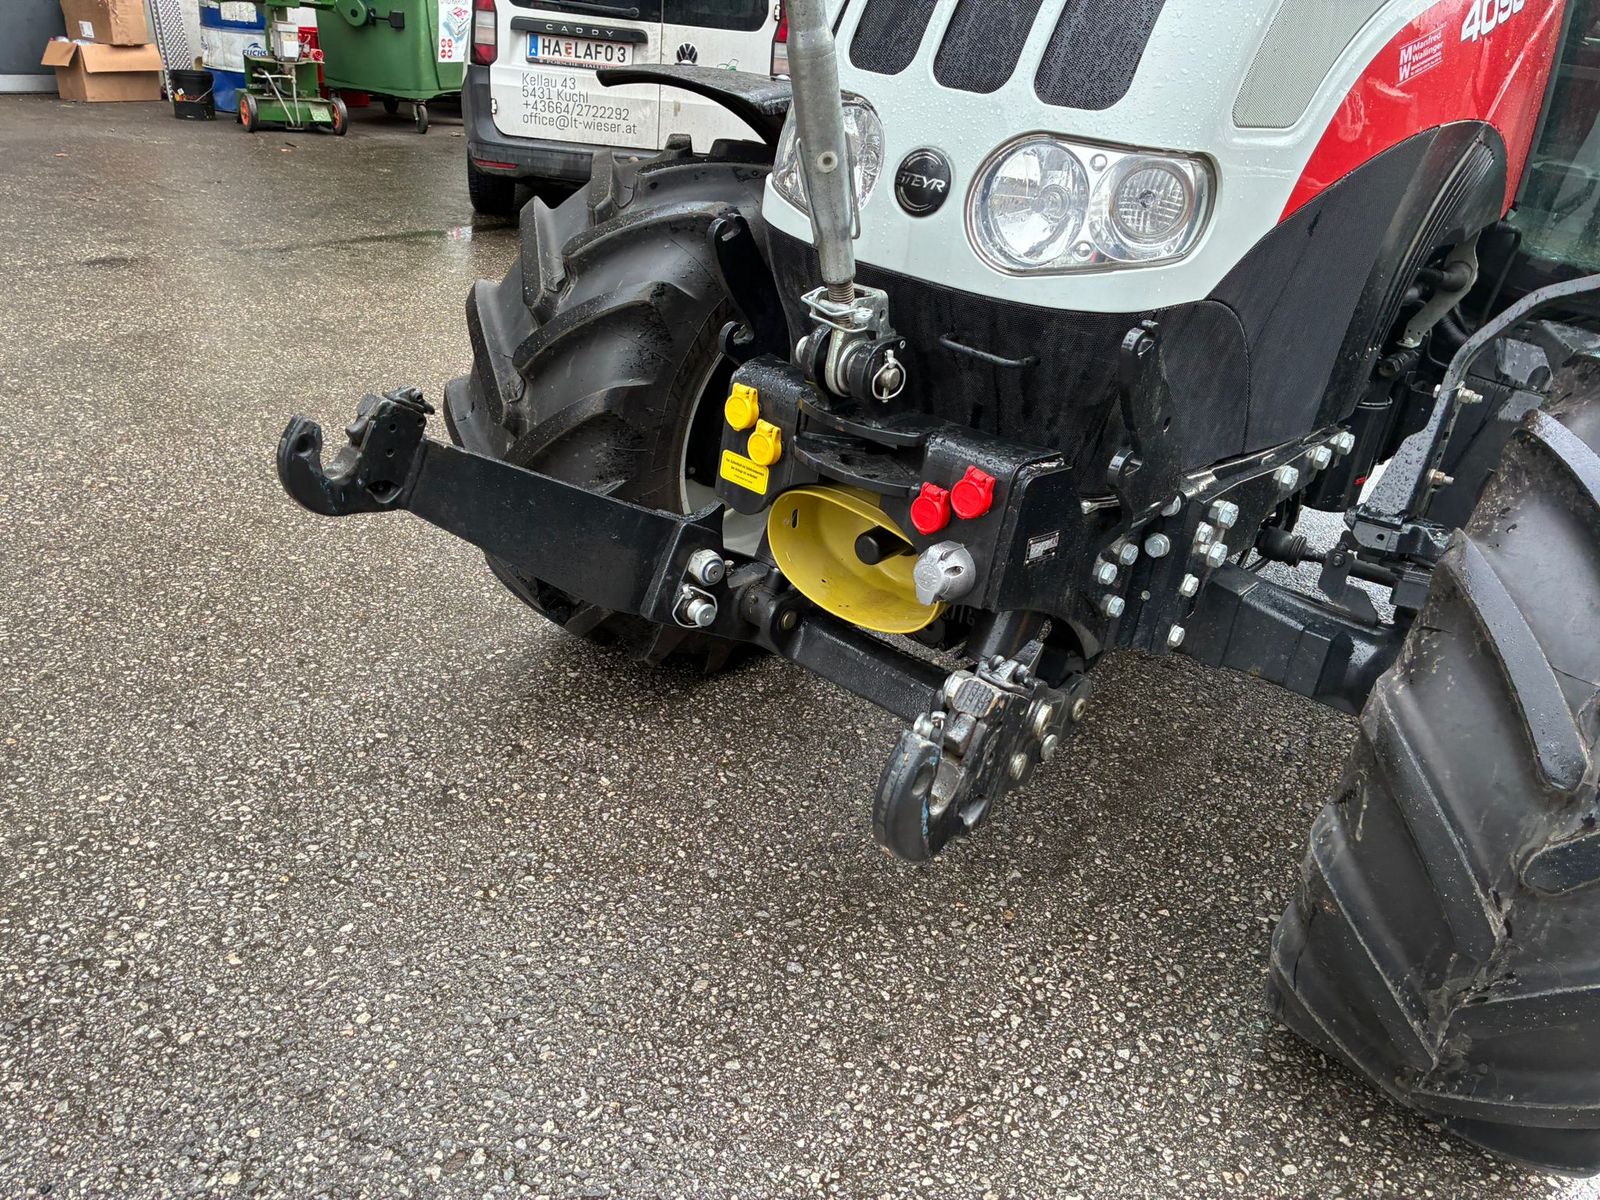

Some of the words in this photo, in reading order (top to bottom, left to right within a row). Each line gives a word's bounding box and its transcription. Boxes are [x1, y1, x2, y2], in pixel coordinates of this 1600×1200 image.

[546, 23, 614, 37] CADDY
[542, 38, 562, 57] HA
[1412, 29, 1442, 52] Manfred
[242, 49, 267, 57] FUCHS
[1412, 40, 1443, 63] Wallinger
[522, 72, 557, 88] Kellau
[560, 77, 576, 90] 43
[522, 86, 553, 100] 5431
[556, 89, 589, 103] Kuchl
[523, 99, 630, 121] +43664/2722292
[523, 112, 637, 134] office@lt-wieser.at
